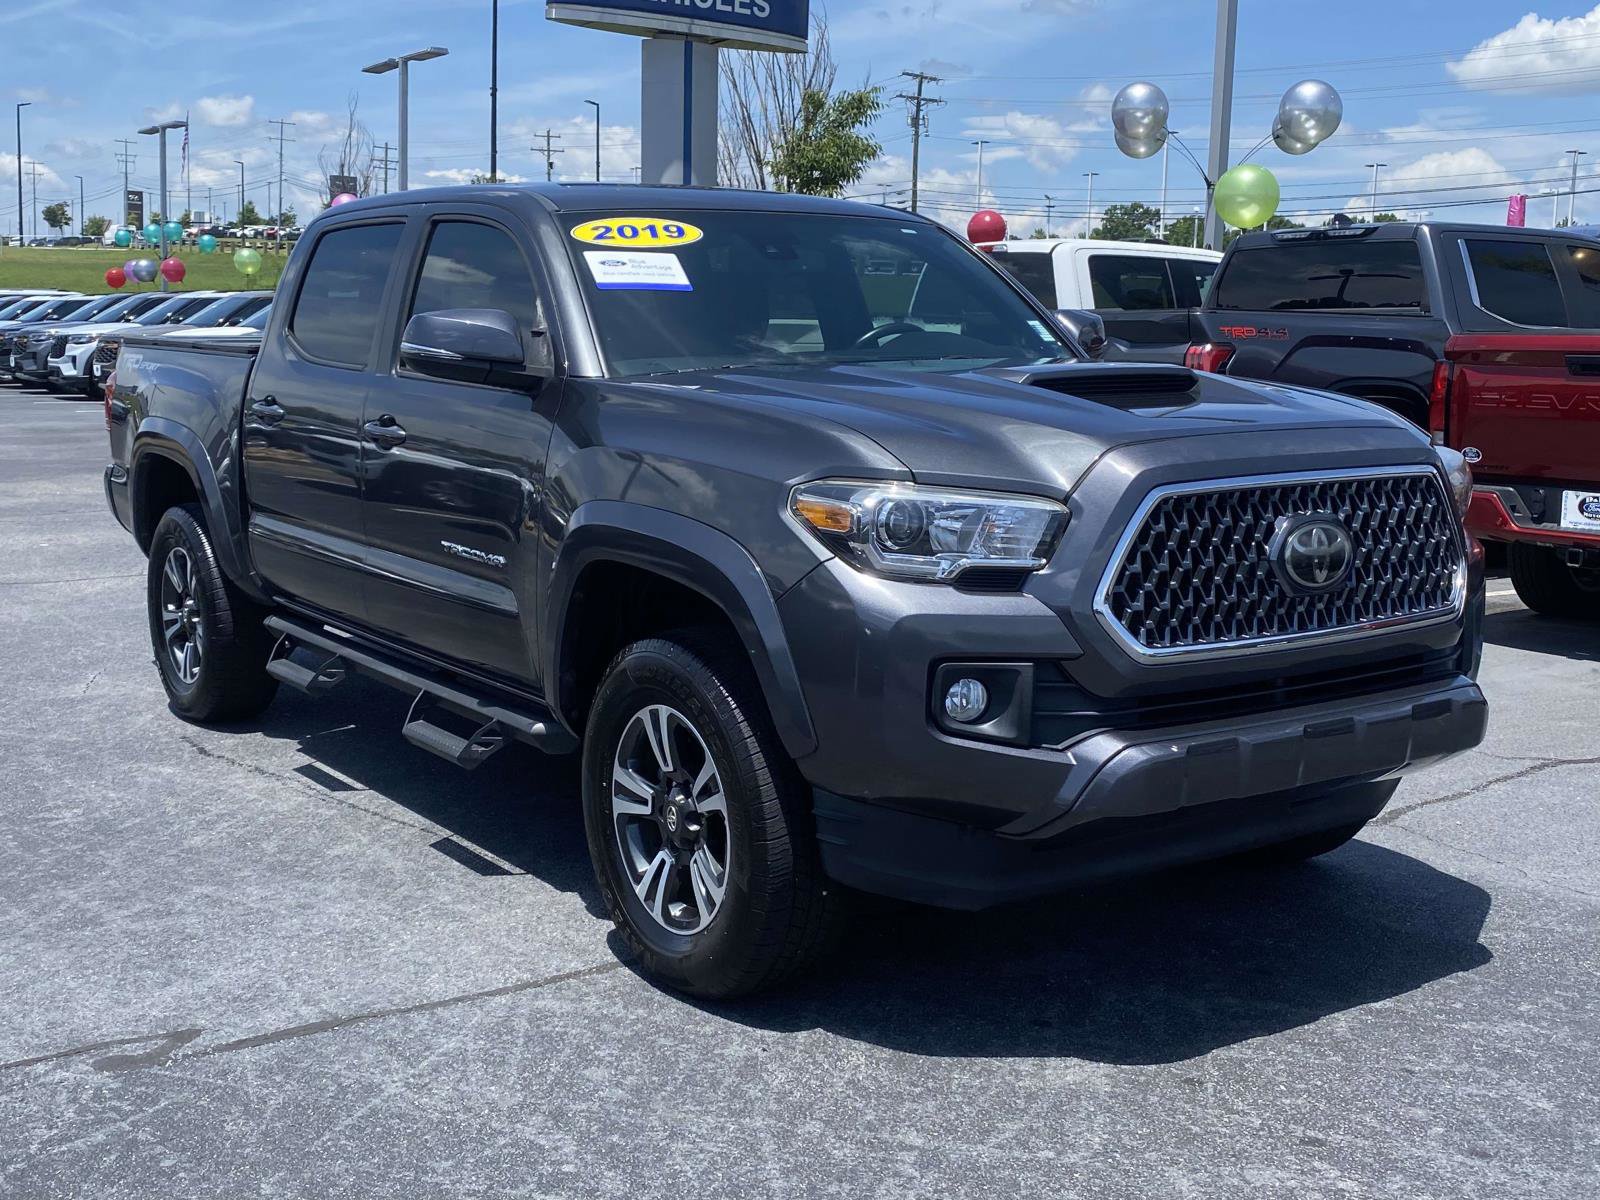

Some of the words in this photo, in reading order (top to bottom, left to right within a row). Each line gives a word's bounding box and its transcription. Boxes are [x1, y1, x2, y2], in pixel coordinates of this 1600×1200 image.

[590, 224, 686, 240] 2019
[1219, 326, 1257, 339] TRD
[440, 540, 506, 568] TACOMA
